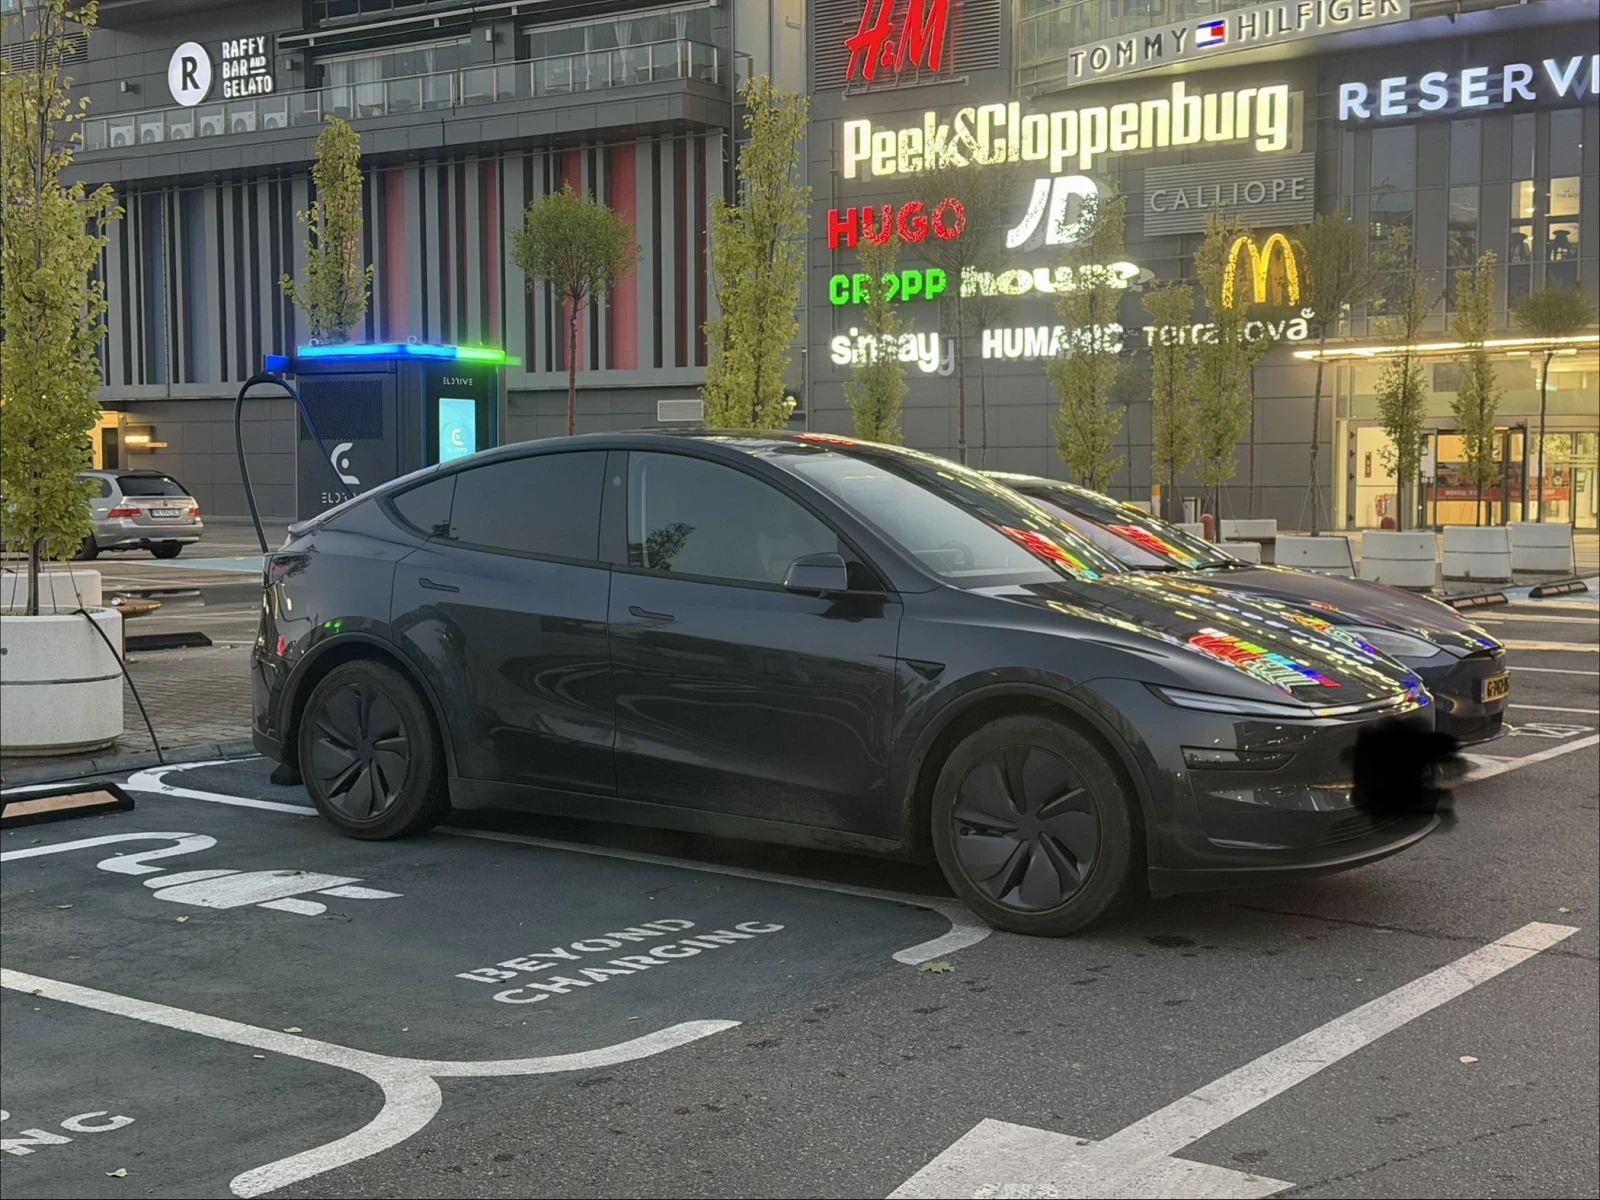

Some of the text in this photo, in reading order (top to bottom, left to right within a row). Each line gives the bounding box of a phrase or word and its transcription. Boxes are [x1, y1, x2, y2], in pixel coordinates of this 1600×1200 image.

[222, 36, 265, 59] RAFFY
[844, 0, 949, 81] H&M
[1069, 0, 1401, 77] TOMMY HILFIGER
[181, 56, 201, 92] R
[222, 56, 267, 79] BAR AND
[223, 75, 273, 98] GELATO
[843, 81, 1289, 179] Peek&Cloppenburg
[1006, 175, 1099, 249] JD
[1151, 177, 1305, 212] CALLIOPE
[827, 197, 967, 249] HUGO
[442, 377, 474, 387] ELDRIVE
[454, 918, 696, 984] BEYOND
[492, 920, 786, 1004] CHARGING
